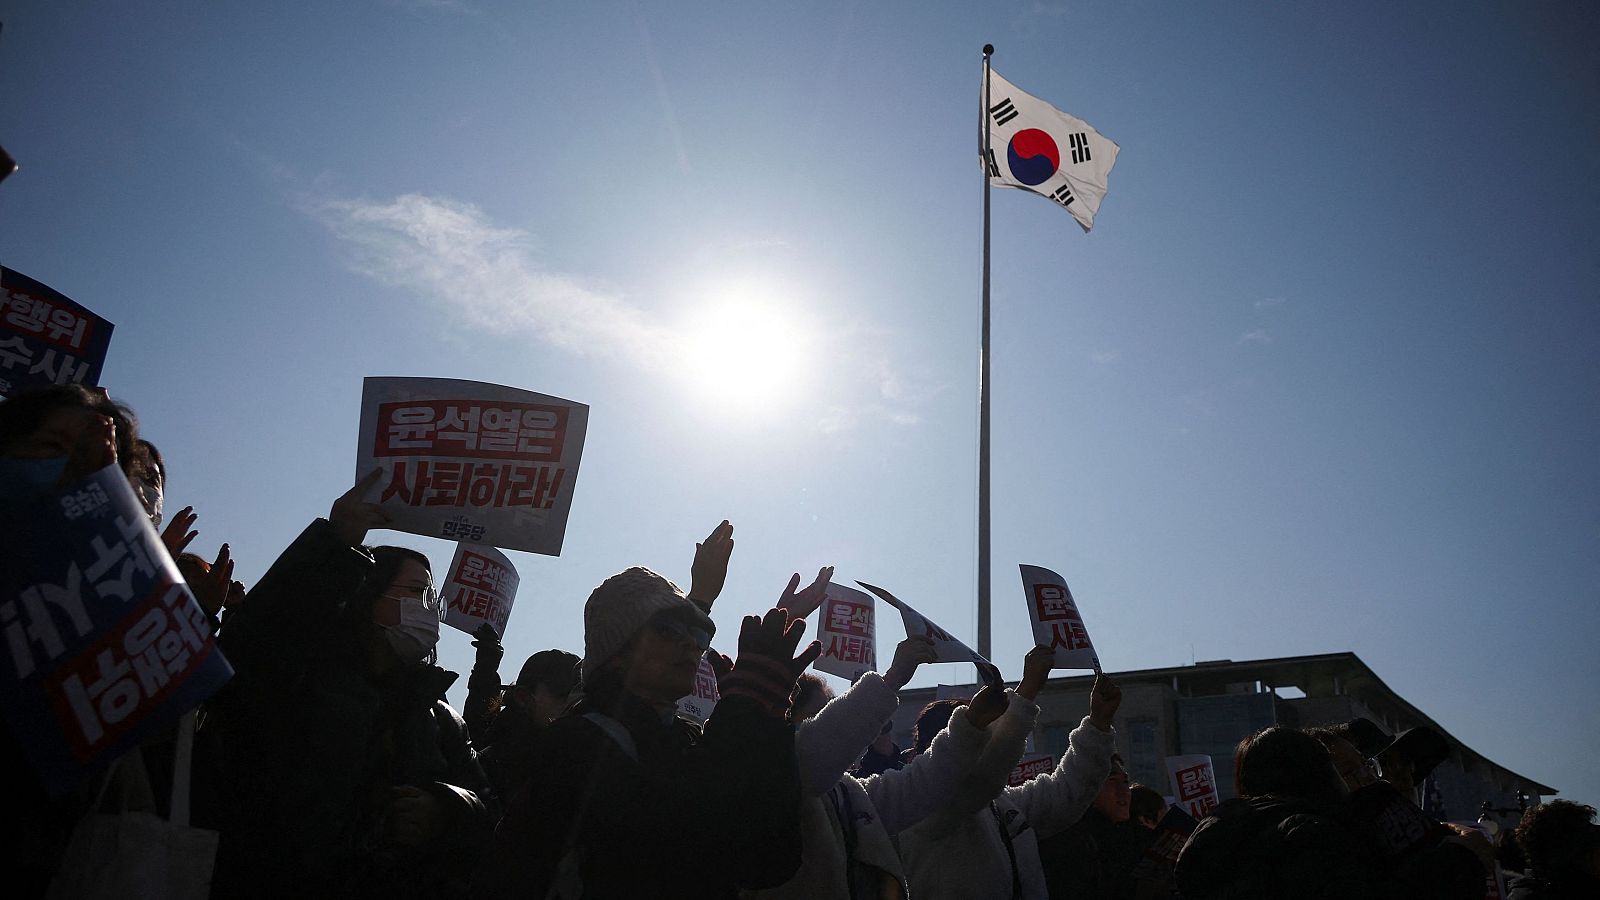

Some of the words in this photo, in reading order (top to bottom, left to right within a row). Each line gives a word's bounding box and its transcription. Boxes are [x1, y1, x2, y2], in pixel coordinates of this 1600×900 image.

[388, 406, 557, 454] 윤석열은
[381, 461, 566, 508] 사퇴하라!
[441, 521, 487, 541] 민주당
